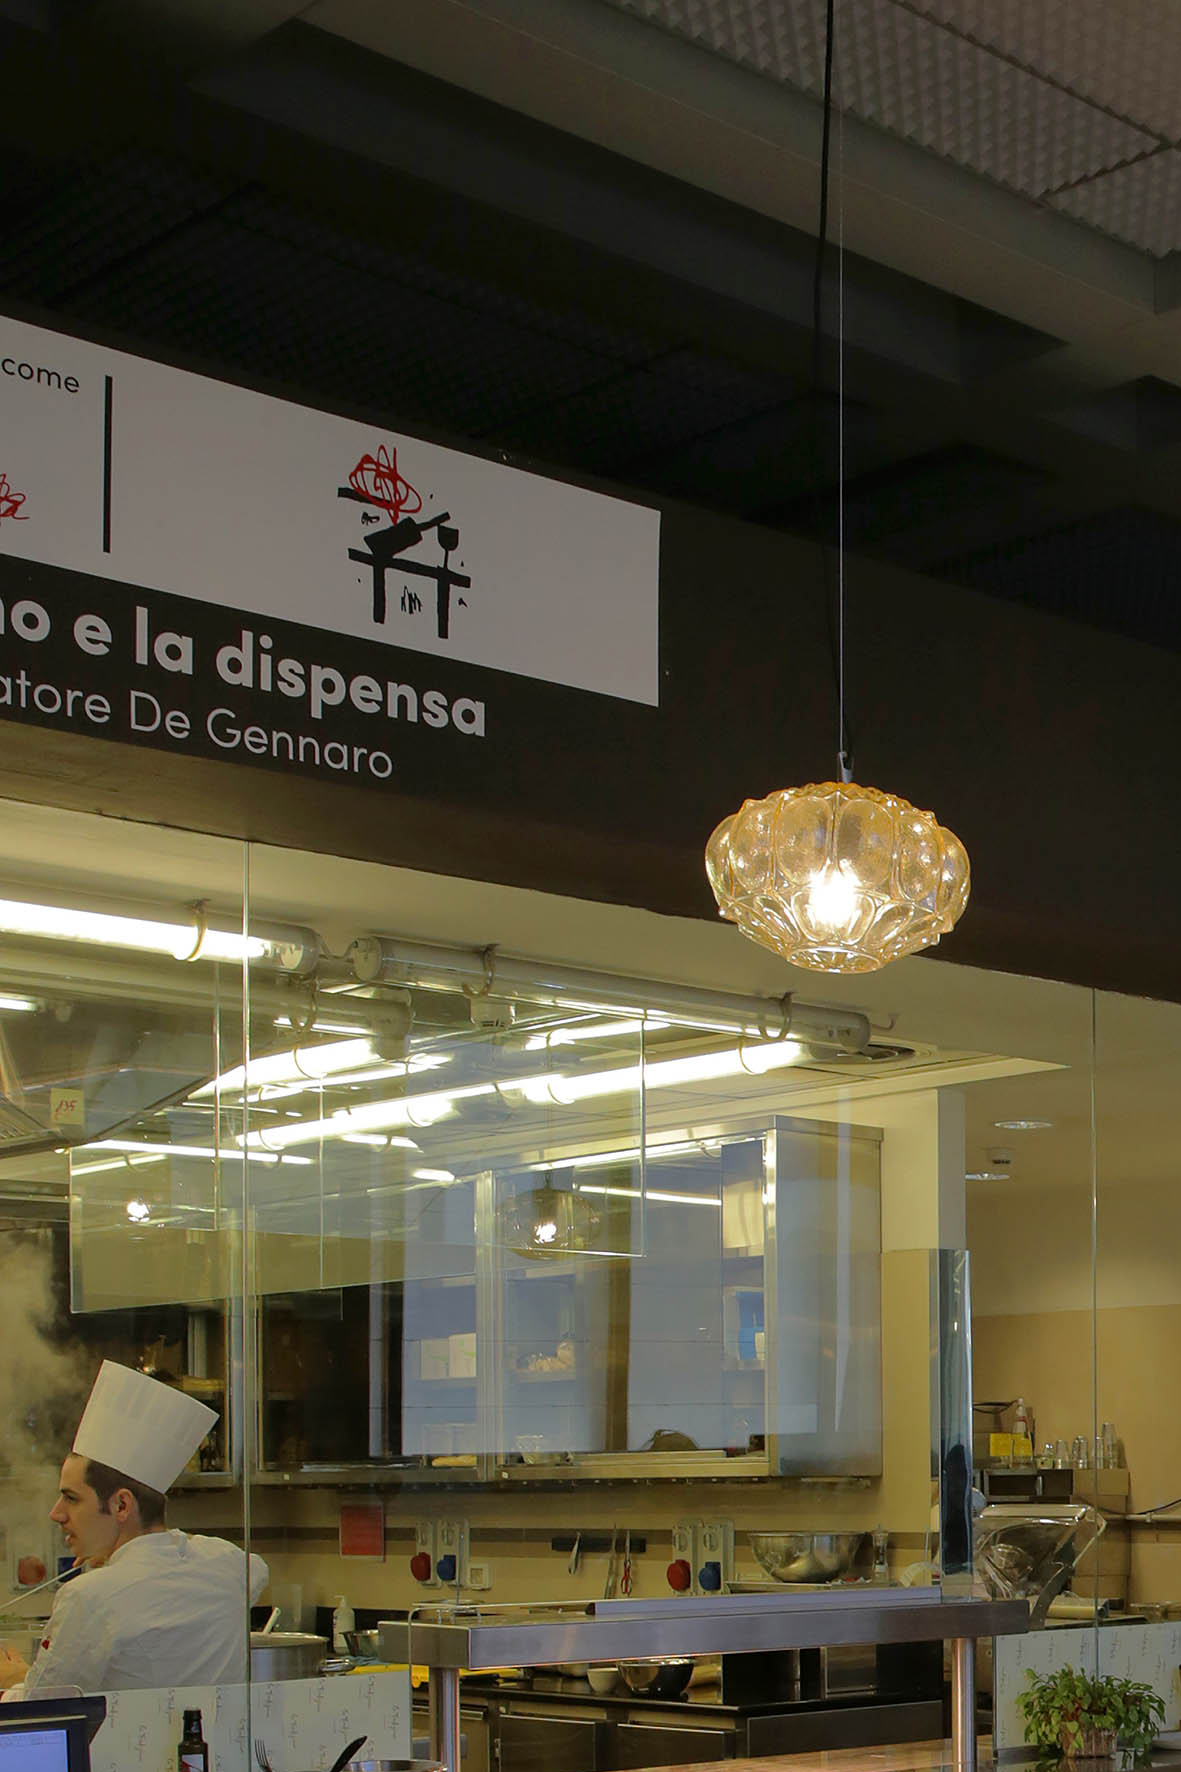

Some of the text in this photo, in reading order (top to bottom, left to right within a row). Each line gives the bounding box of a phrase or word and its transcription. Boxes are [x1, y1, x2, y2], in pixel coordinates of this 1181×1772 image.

[1, 357, 80, 393] come
[0, 597, 486, 737] o e la dispensa
[130, 690, 191, 739] De
[206, 707, 393, 779] Gennaro
